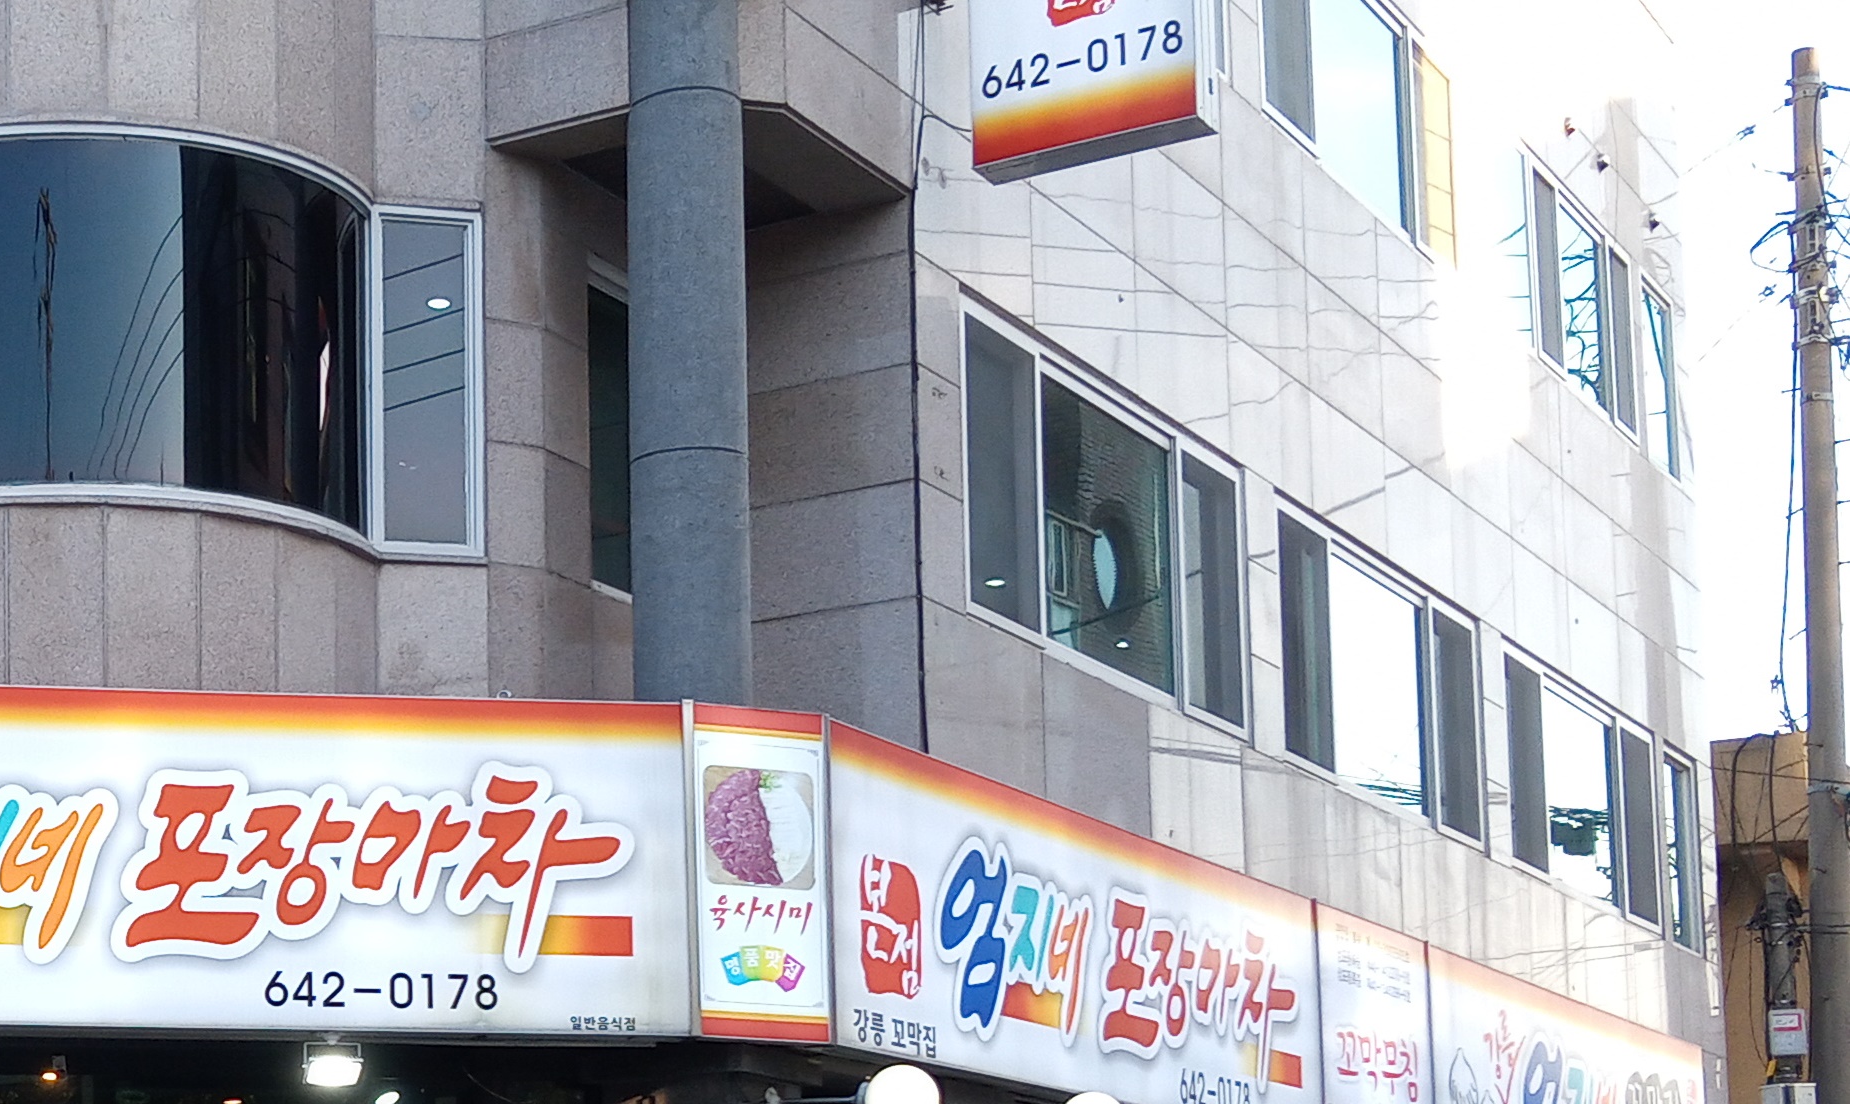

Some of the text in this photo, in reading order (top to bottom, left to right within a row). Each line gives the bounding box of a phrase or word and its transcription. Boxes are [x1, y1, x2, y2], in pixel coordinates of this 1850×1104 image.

[981, 19, 1184, 99] 642-0178
[124, 773, 622, 957] 포장마차
[709, 897, 814, 936] 육사시미
[860, 853, 922, 999] 본점
[262, 971, 500, 1011] 642-0178
[940, 848, 1090, 1030] 엄지네
[1104, 898, 1297, 1090] 포장마차
[569, 1014, 637, 1032] 일반음식점
[852, 1009, 937, 1059] 강릉 꼬막집
[1336, 1030, 1418, 1102] 꼬막무침
